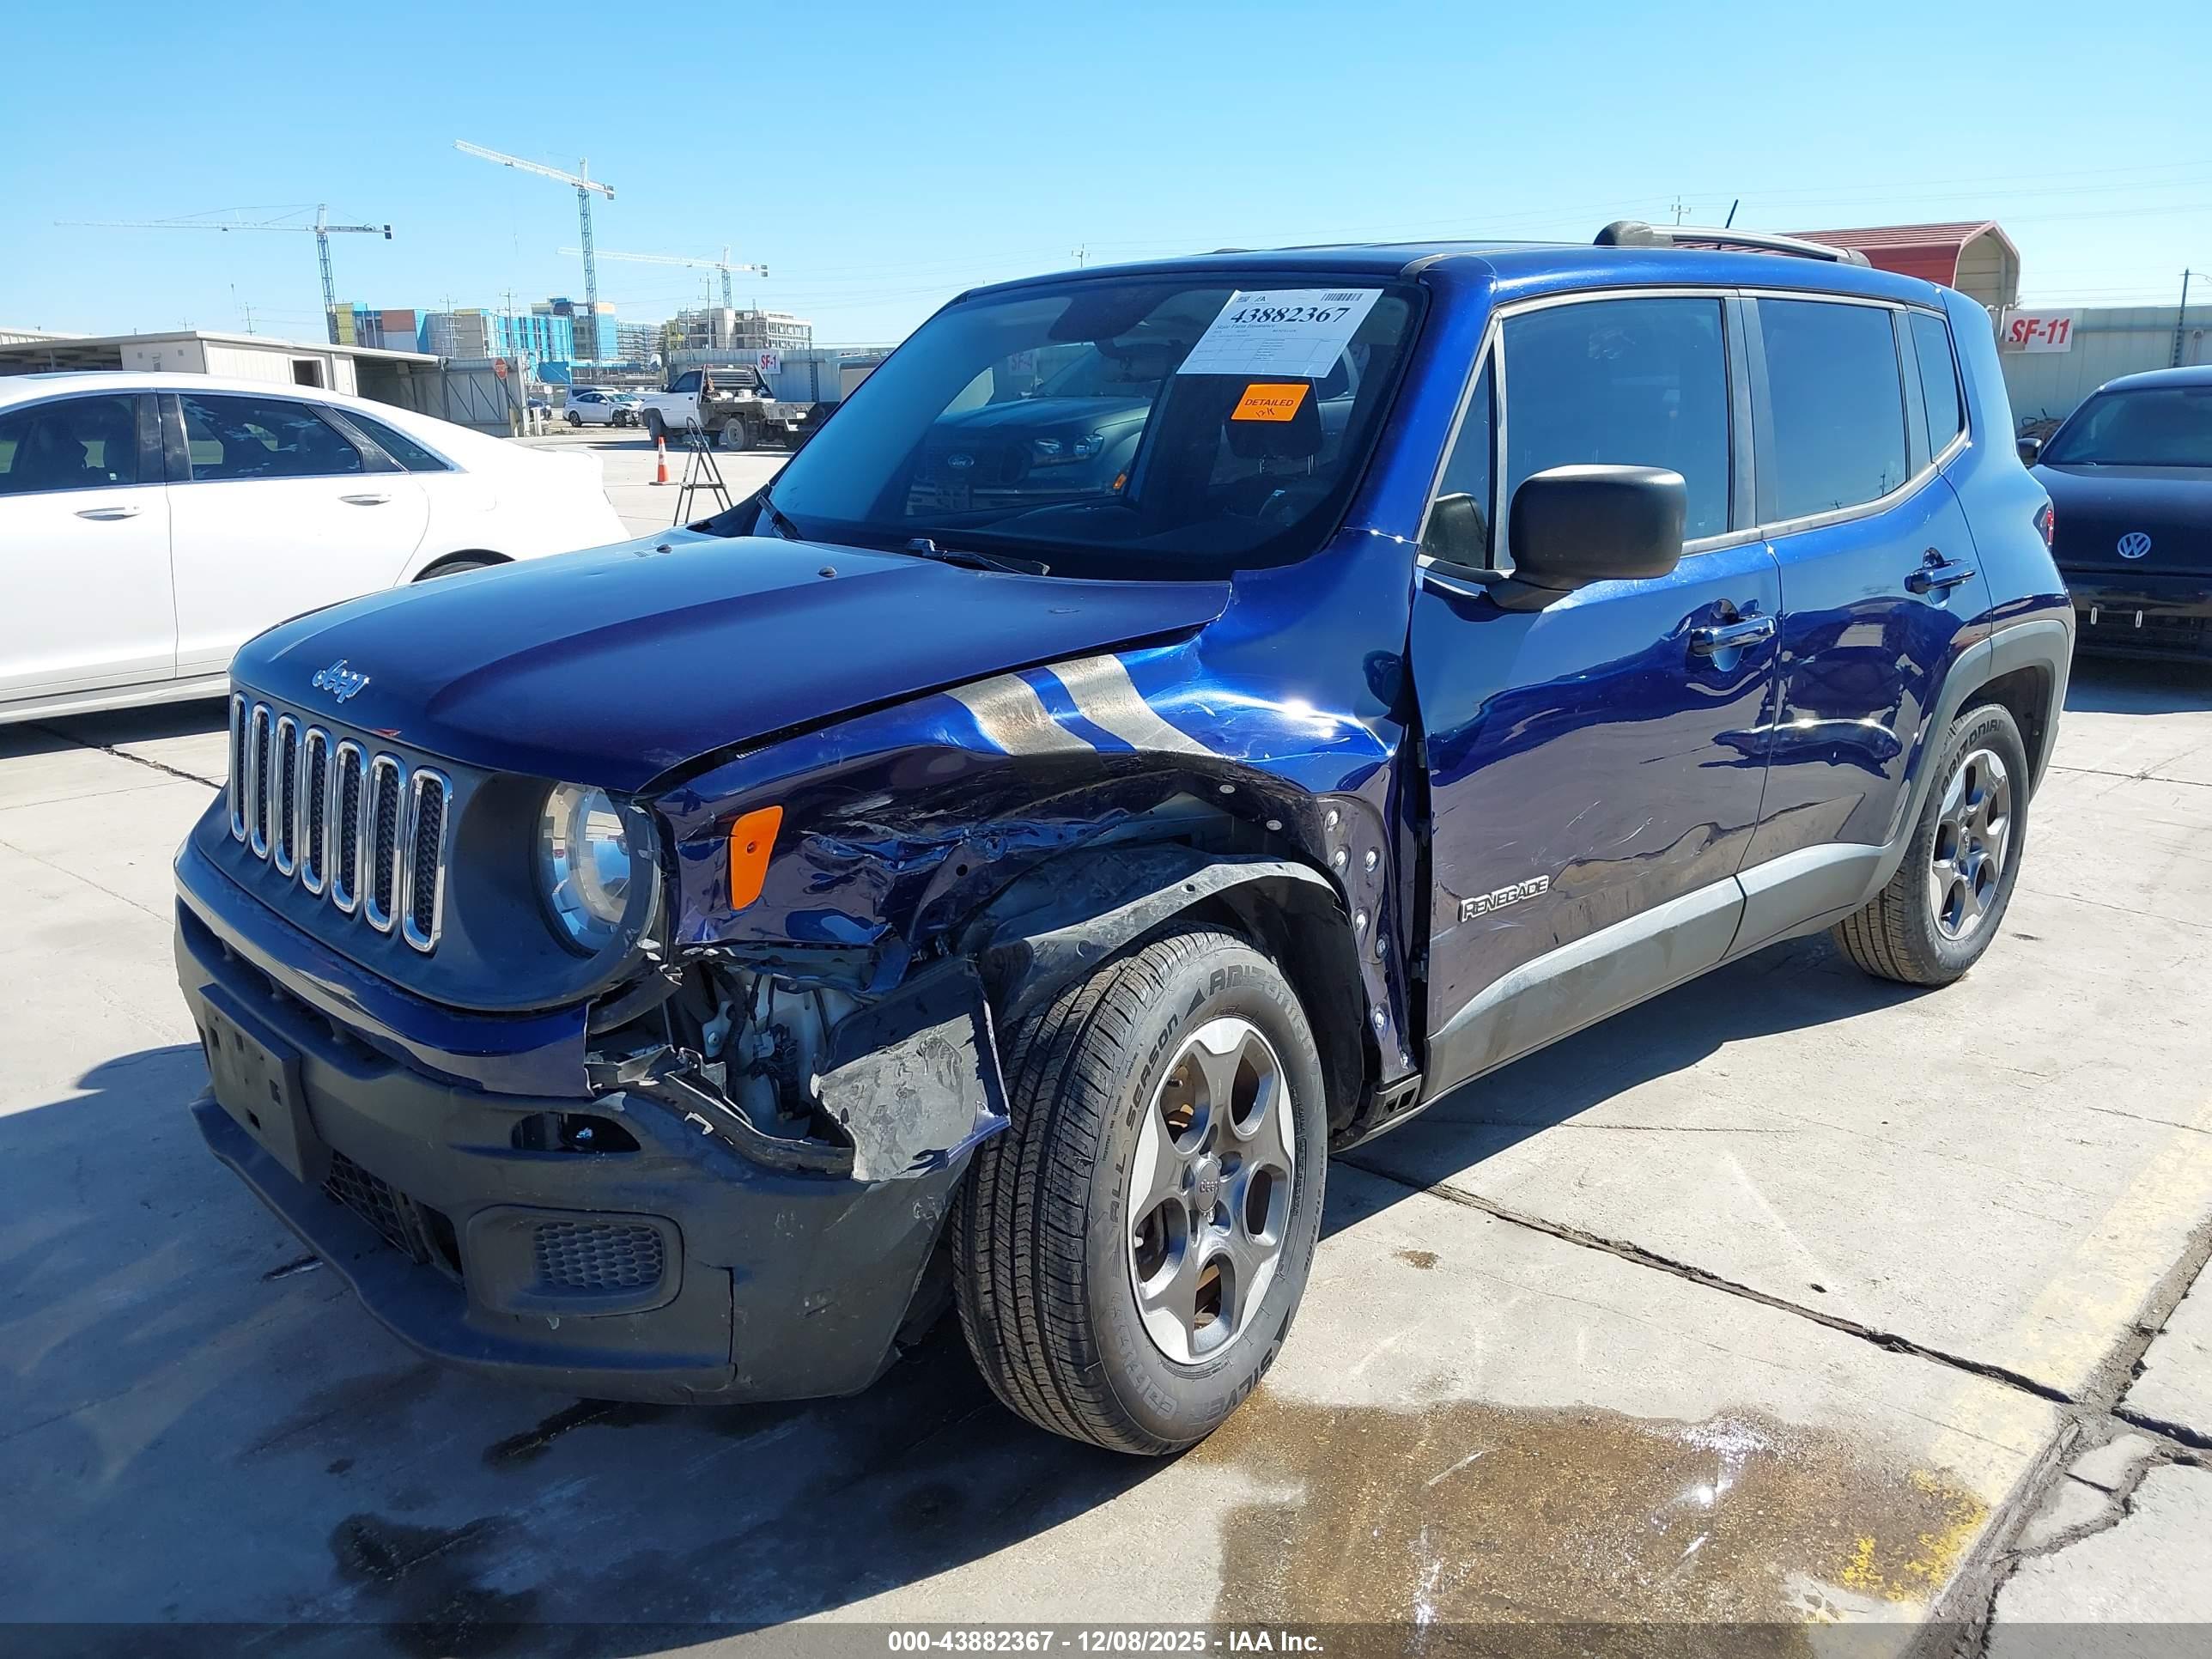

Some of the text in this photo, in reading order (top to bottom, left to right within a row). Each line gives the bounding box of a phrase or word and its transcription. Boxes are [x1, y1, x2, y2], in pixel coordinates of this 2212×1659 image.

[1231, 307, 1350, 324] 43882367
[2008, 318, 2071, 344] SF-11
[761, 354, 776, 370] SF-1
[1244, 398, 1294, 407] DETAILED
[312, 659, 370, 704] Jeep
[1461, 874, 1549, 923] RENEGADE
[1109, 1153, 1127, 1224] ALL
[1126, 1013, 1179, 1131] SEASON
